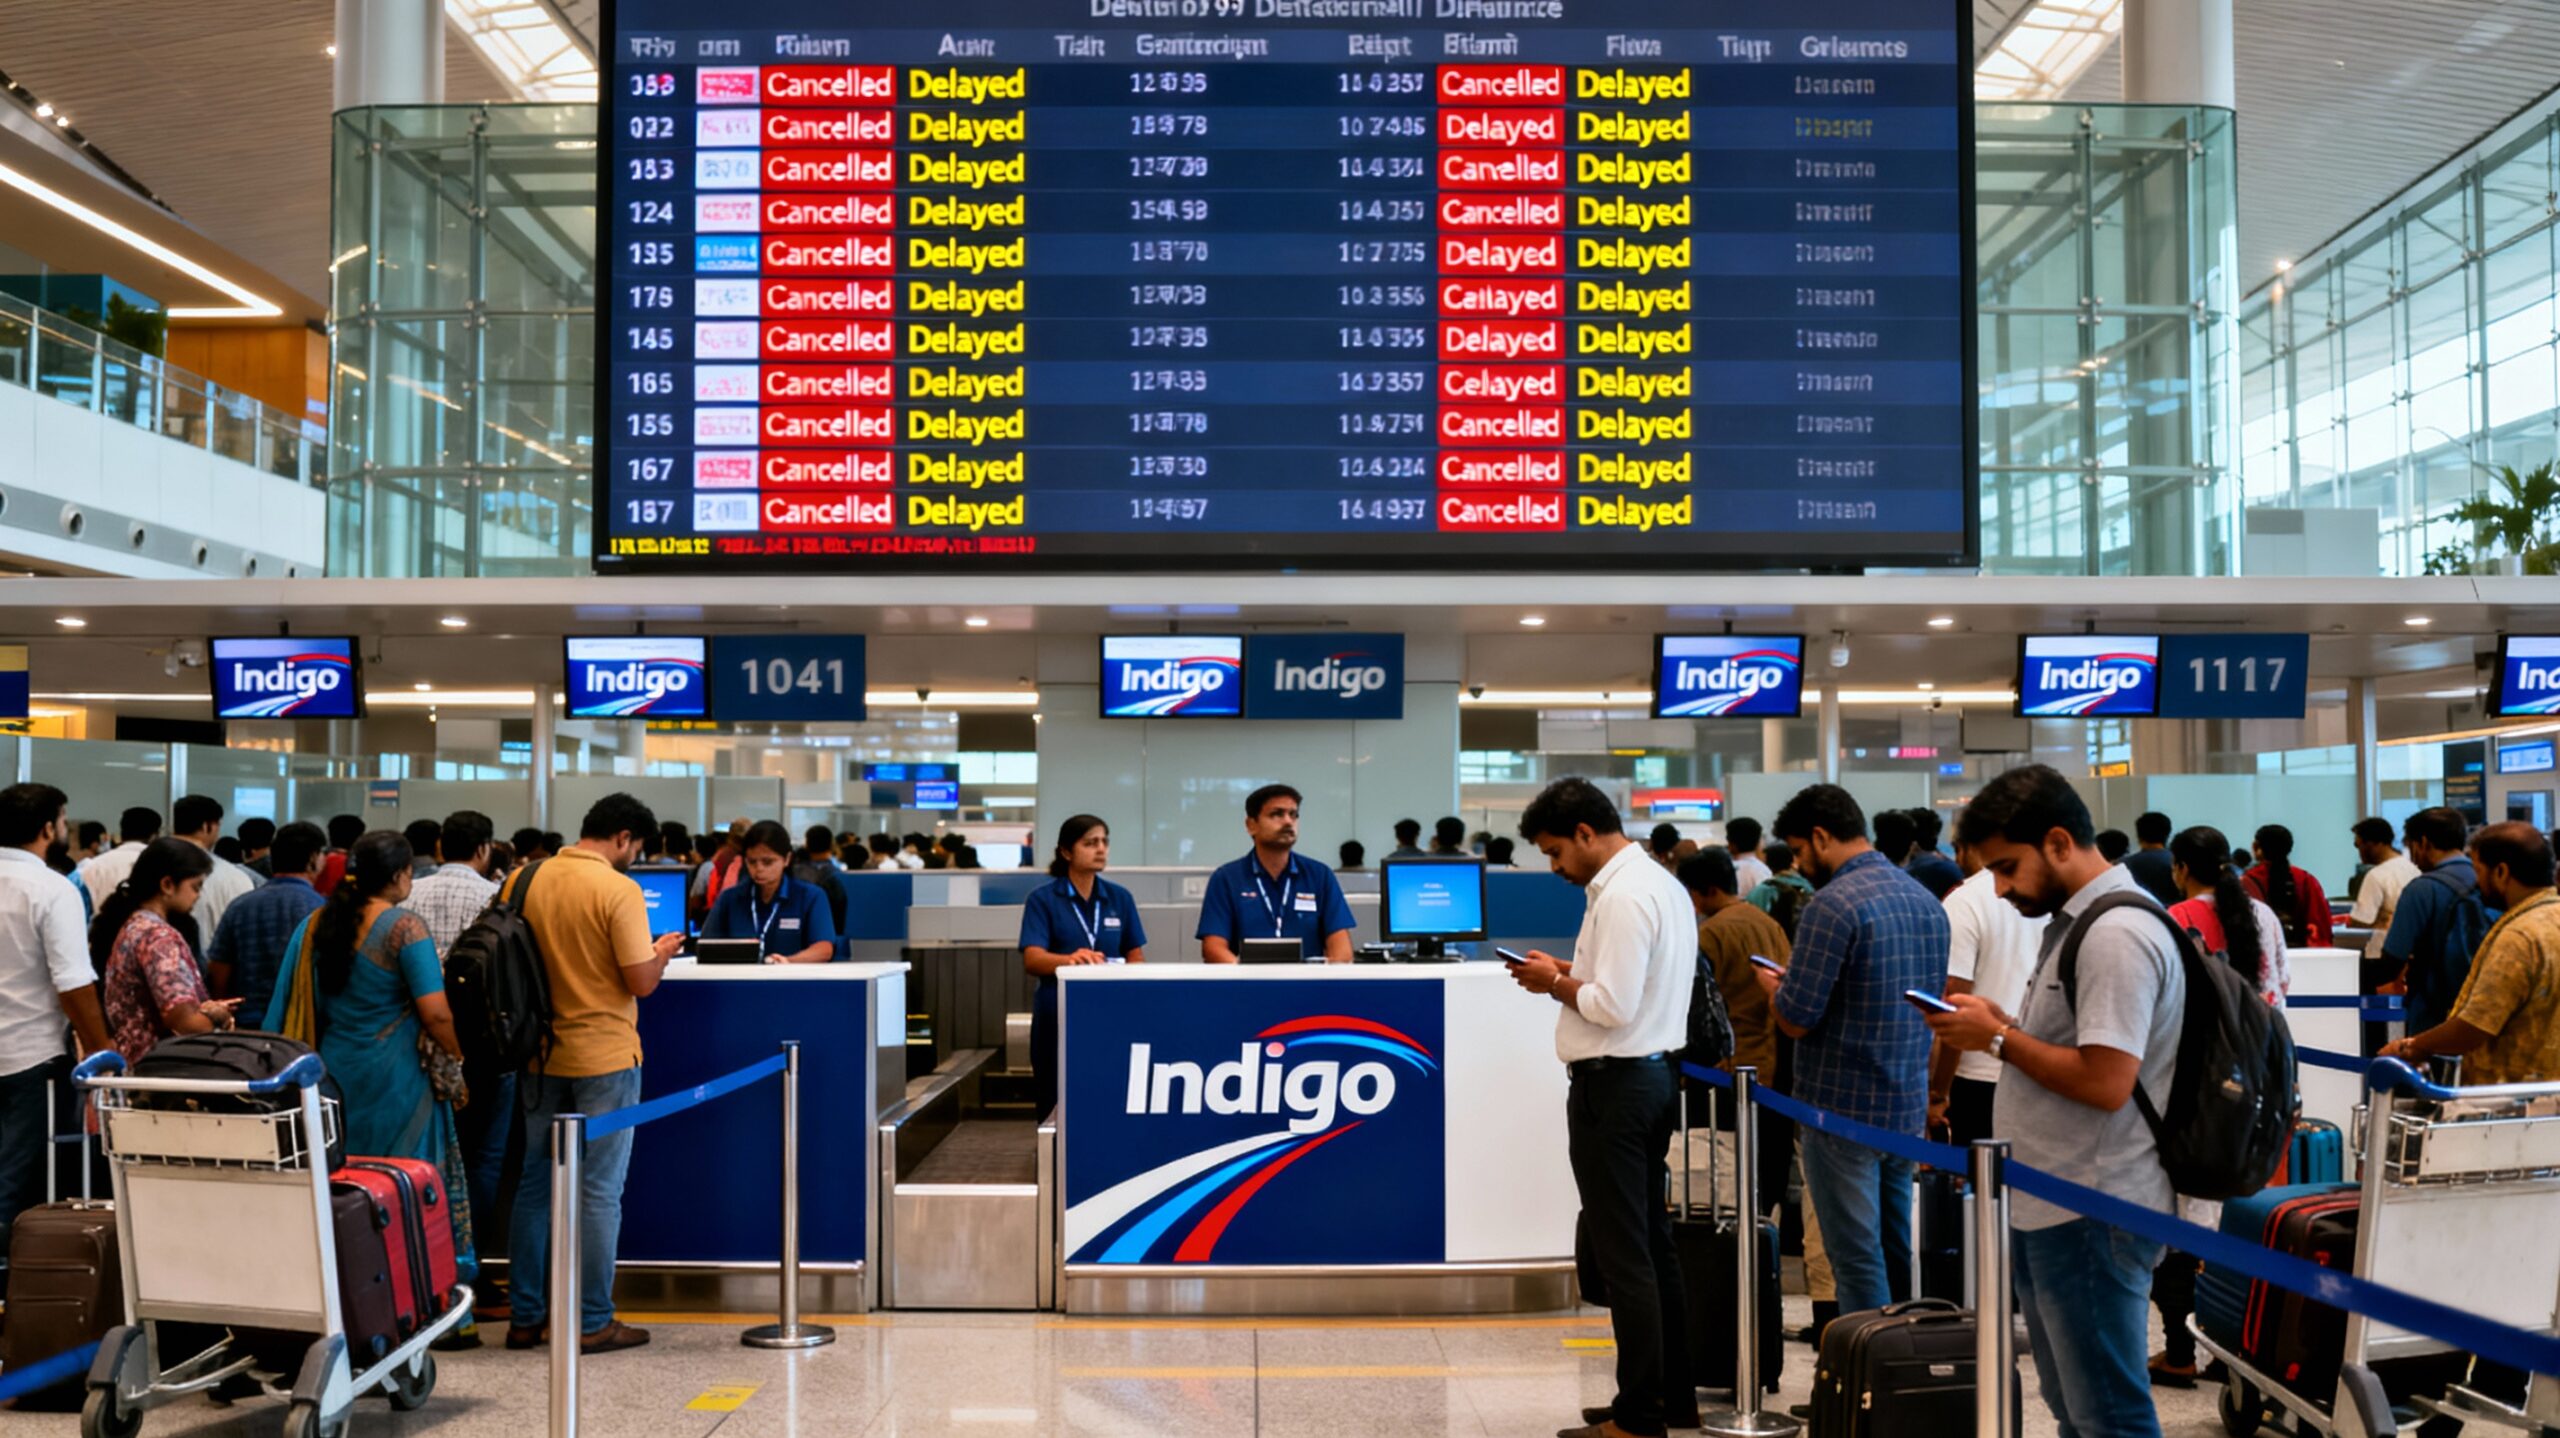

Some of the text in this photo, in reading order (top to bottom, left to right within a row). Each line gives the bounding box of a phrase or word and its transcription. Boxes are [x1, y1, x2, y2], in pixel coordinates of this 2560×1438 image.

[768, 70, 890, 97] Cancelled
[910, 68, 1024, 104] Delayed
[1443, 70, 1559, 96] Cancelled
[1578, 69, 1689, 104] Delayed
[768, 112, 890, 139] Cancelled
[910, 111, 1024, 147] Delayed
[1447, 114, 1554, 145] Delayed
[1579, 111, 1689, 147] Delayed
[768, 153, 891, 181] Cancelled
[910, 153, 1024, 188] Delayed
[1578, 153, 1690, 189] Delayed
[630, 202, 673, 223] 124
[768, 198, 891, 223] Cancelled
[910, 195, 1024, 230] Delayed
[1443, 198, 1559, 224] Cancelled
[1579, 196, 1690, 232] Delayed
[767, 238, 890, 265] Cancelled
[910, 237, 1024, 274] Delayed
[1447, 238, 1556, 271] Delayed
[1579, 238, 1690, 274] Delayed
[768, 283, 890, 309] Cancelled
[910, 281, 1023, 317] Delayed
[1579, 281, 1690, 317] Delayed
[767, 324, 890, 351] Cancelled
[909, 323, 1023, 360] Delayed
[1447, 324, 1555, 357] Delayed
[1579, 323, 1690, 359] Delayed
[767, 368, 890, 395] Cancelled
[910, 367, 1023, 402] Delayed
[1579, 367, 1690, 403] Delayed
[766, 410, 890, 437] Cancelled
[909, 409, 1023, 445] Delayed
[1443, 410, 1559, 437] Cancelled
[1579, 408, 1690, 445] Delayed
[629, 458, 673, 480] 167
[767, 453, 890, 481] Cancelled
[909, 452, 1023, 488] Delayed
[1442, 455, 1559, 481] Cancelled
[1579, 452, 1690, 488] Delayed
[766, 495, 891, 523] Cancelled
[909, 495, 1023, 531] Delayed
[1443, 496, 1559, 523] Cancelled
[1579, 495, 1691, 531] Delayed
[234, 661, 340, 697] Indigo
[587, 663, 688, 698] Indigo
[741, 659, 843, 695] 1041
[1121, 661, 1224, 698] Indigo
[1275, 658, 1386, 698] Indigo
[1676, 660, 1783, 697] Indigo
[2040, 661, 2142, 696] Indigo
[2189, 657, 2287, 692] 1117
[1126, 1041, 1396, 1134] Indigo
